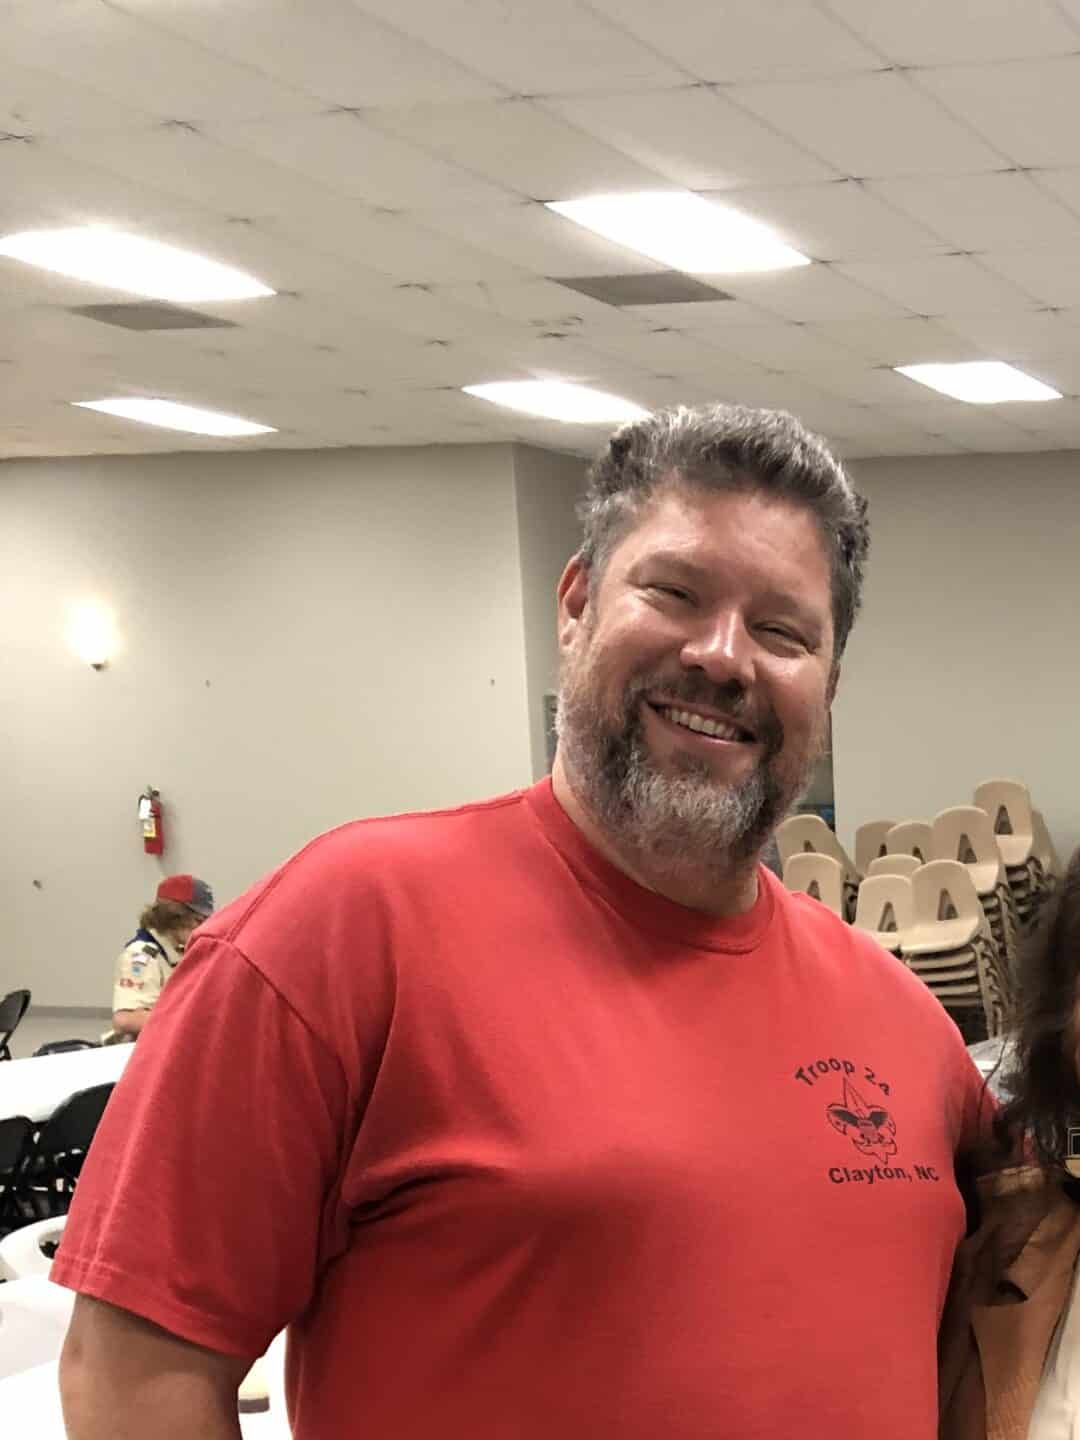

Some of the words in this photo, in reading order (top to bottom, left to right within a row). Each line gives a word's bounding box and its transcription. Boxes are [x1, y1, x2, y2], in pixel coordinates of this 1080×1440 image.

[795, 1058, 855, 1087] Troop
[828, 1164, 912, 1184] Clayton,
[914, 1164, 940, 1182] NC
